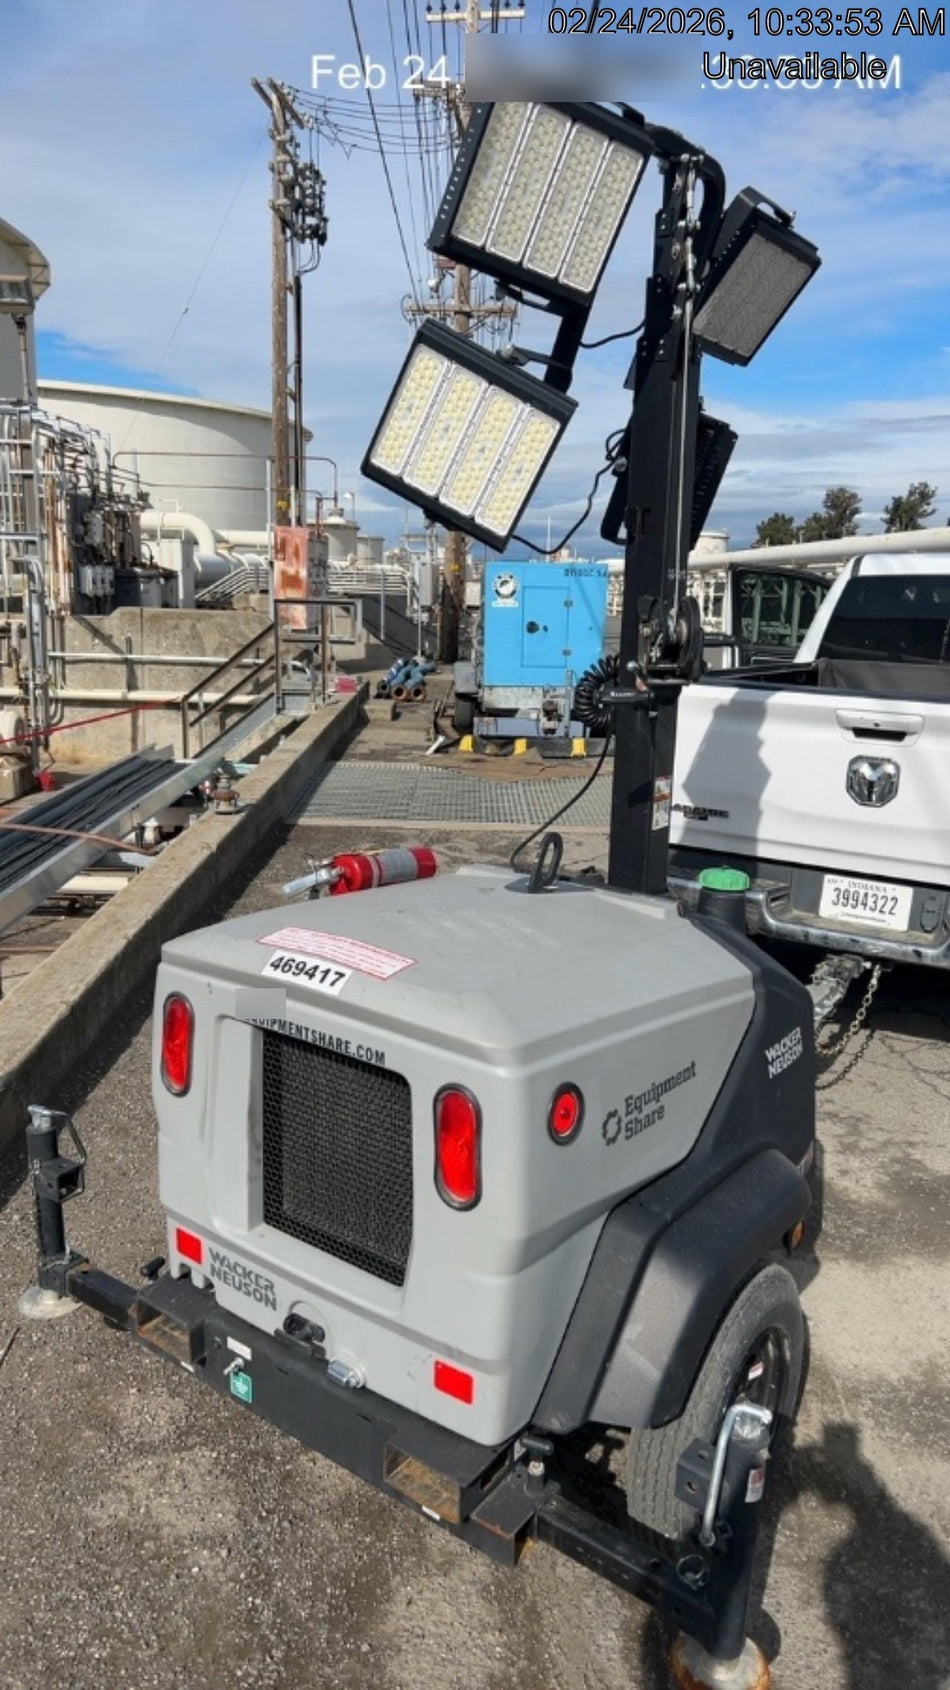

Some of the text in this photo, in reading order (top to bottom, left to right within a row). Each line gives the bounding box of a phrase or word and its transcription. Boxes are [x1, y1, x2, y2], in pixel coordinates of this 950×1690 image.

[831, 887, 899, 915] 3994322
[269, 955, 347, 987] 469417
[246, 1018, 386, 1066] UIPMENTSHARE.COM
[764, 1026, 803, 1062] WACKER
[766, 1039, 803, 1079] NEUSON
[624, 1060, 698, 1118] Equipment
[624, 1105, 666, 1141] Share
[208, 1247, 277, 1297] WACKER
[210, 1263, 278, 1312] NEUSON
